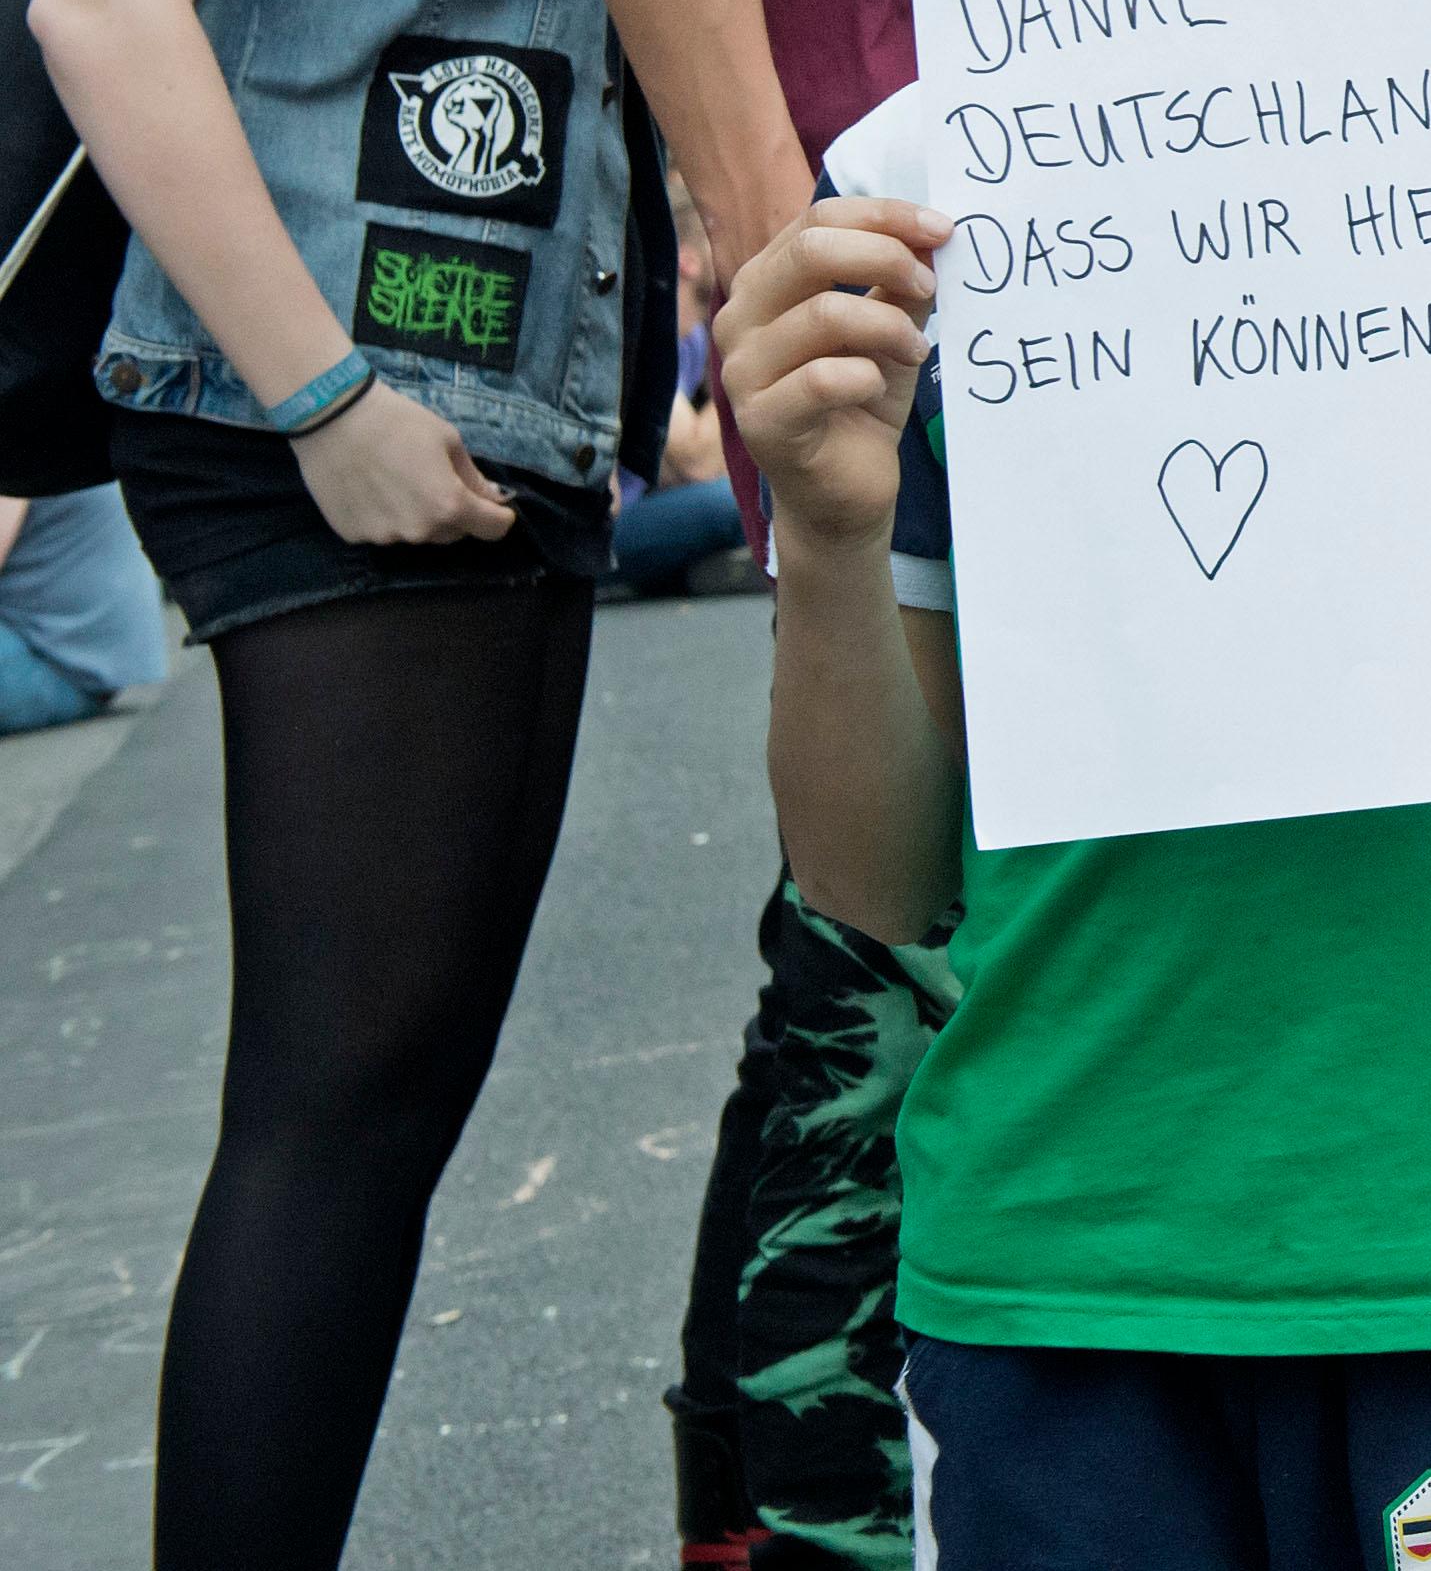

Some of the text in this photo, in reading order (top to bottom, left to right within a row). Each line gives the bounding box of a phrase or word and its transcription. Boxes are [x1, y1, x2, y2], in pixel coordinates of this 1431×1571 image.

[430, 57, 541, 141] LOVE HARDCORE
[400, 104, 519, 193] HATE HOMOPHOBIA
[952, 213, 1134, 294] DASS
[1171, 198, 1302, 265] WIR
[967, 328, 1132, 404] SEIN
